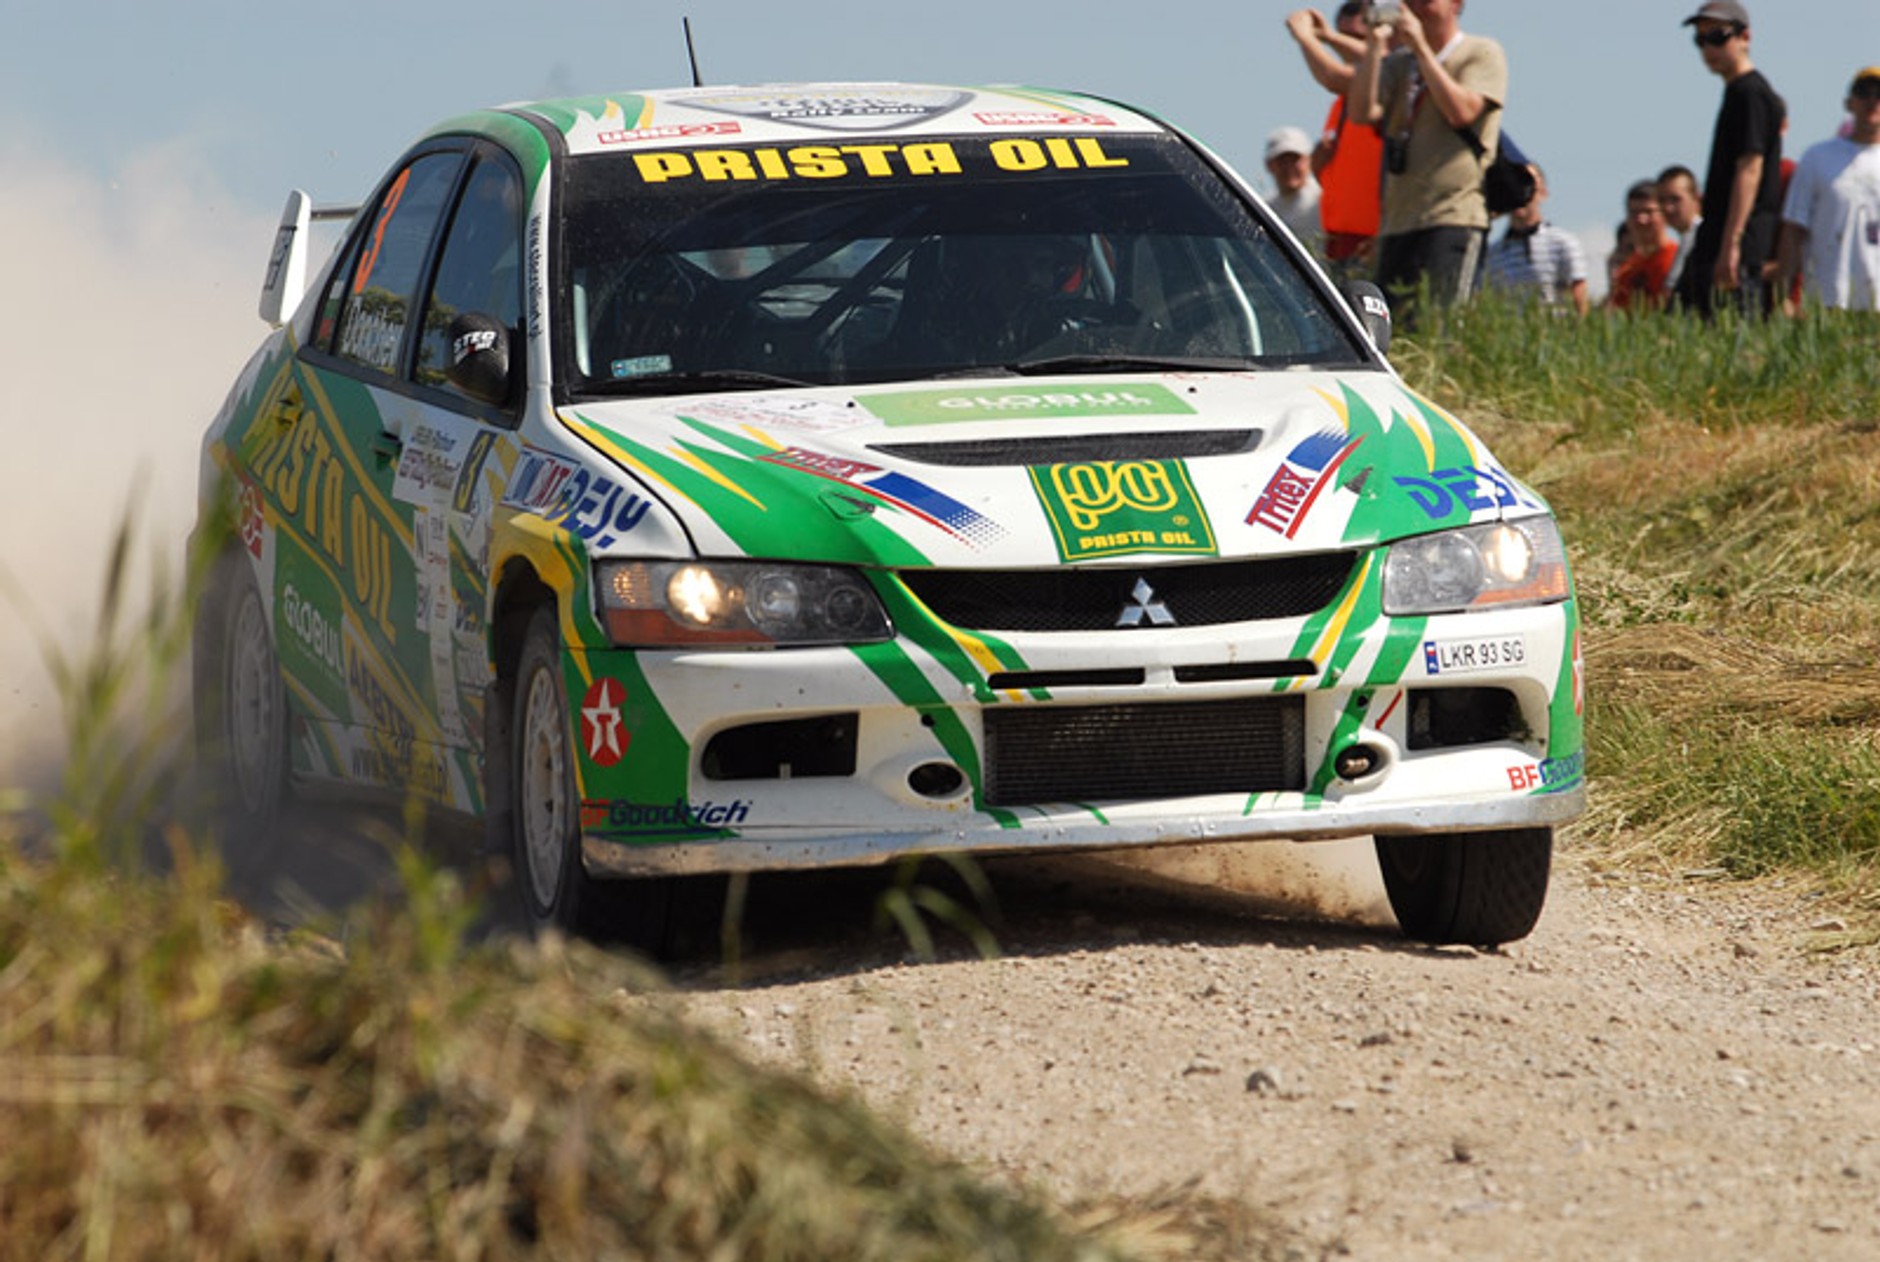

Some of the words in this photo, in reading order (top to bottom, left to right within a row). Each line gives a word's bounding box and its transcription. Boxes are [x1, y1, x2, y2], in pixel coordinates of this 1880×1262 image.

[632, 142, 963, 183] PRISTA
[987, 136, 1130, 174] OIL
[353, 168, 411, 294] 3
[352, 492, 397, 646] OIL
[1078, 530, 1156, 549] PRISTA
[1161, 531, 1196, 545] OIL
[283, 582, 346, 677] GLOBUL
[1440, 644, 1477, 668] LKR
[1480, 643, 1498, 664] 93
[1502, 640, 1524, 662] SG
